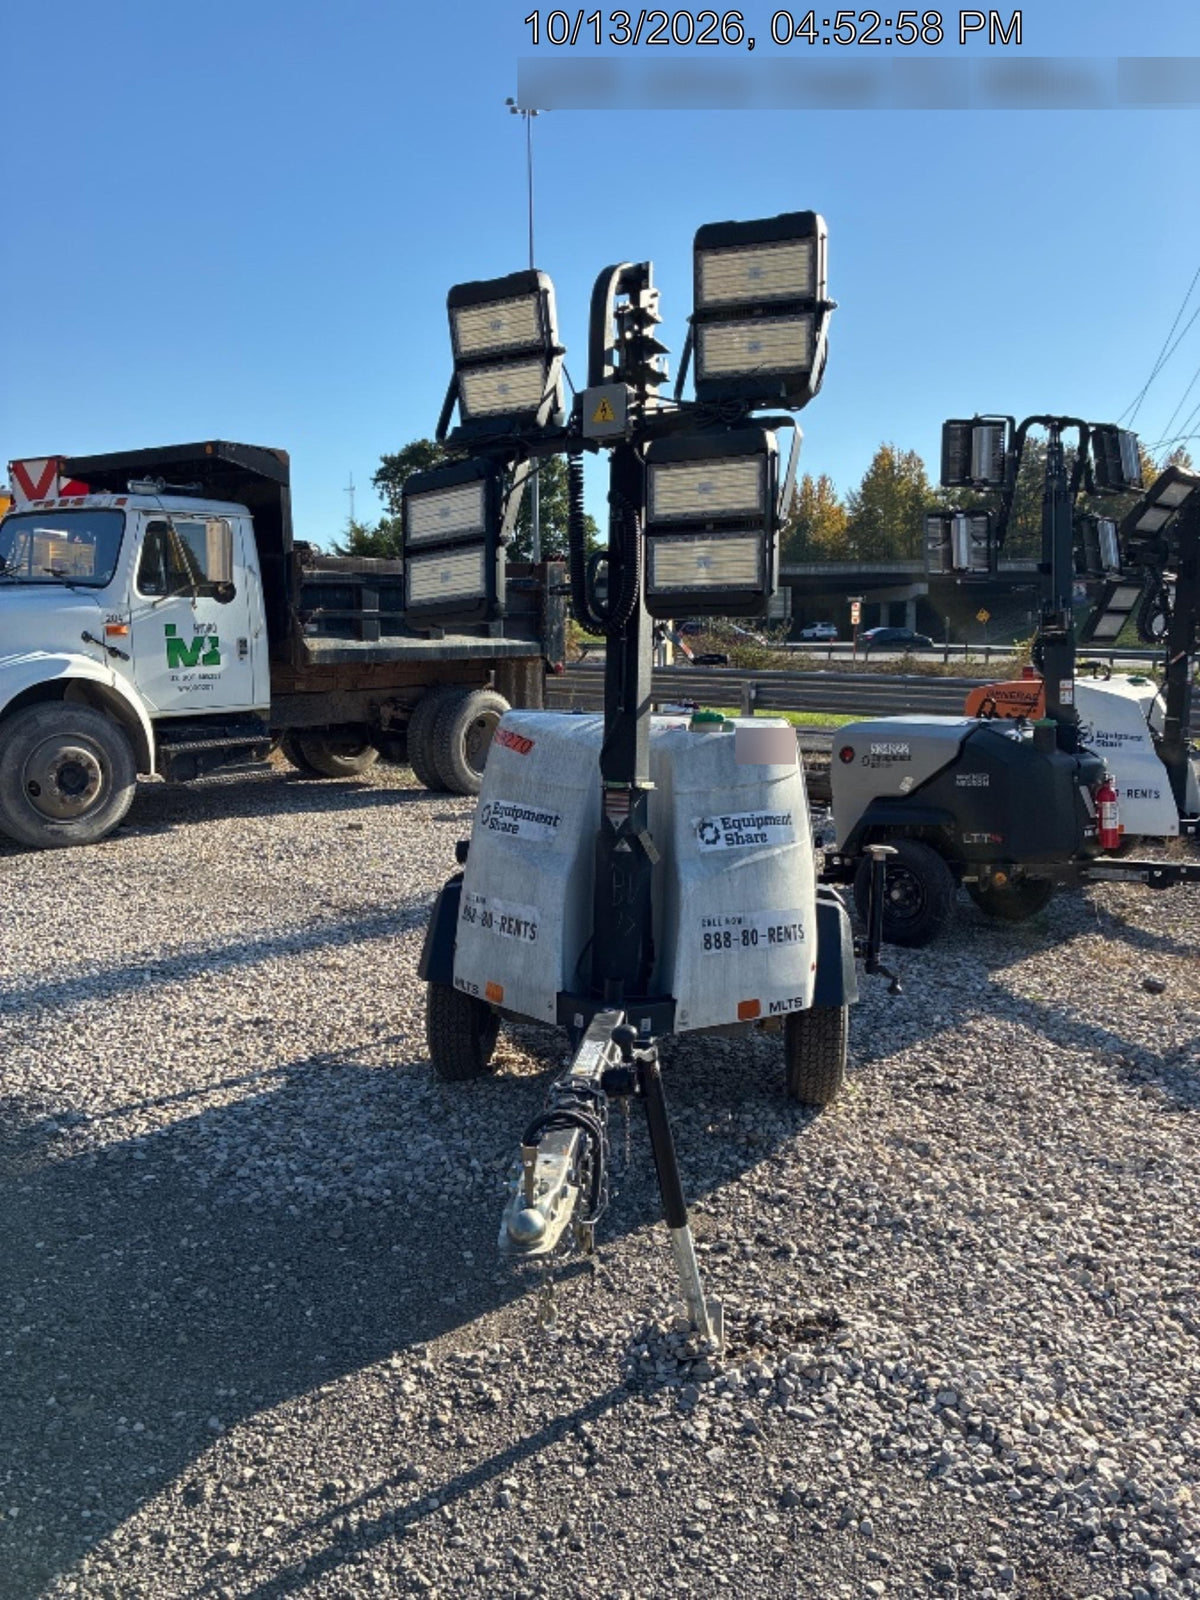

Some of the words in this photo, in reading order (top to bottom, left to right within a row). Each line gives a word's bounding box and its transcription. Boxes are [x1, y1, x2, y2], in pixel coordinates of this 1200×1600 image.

[491, 801, 561, 828] Equipment
[719, 813, 793, 833] Equipment
[488, 818, 520, 835] Share
[724, 832, 769, 846] Share
[702, 917, 722, 927] CALL
[703, 924, 805, 950] 888-80-RENTS
[769, 997, 803, 1014] MLTS
